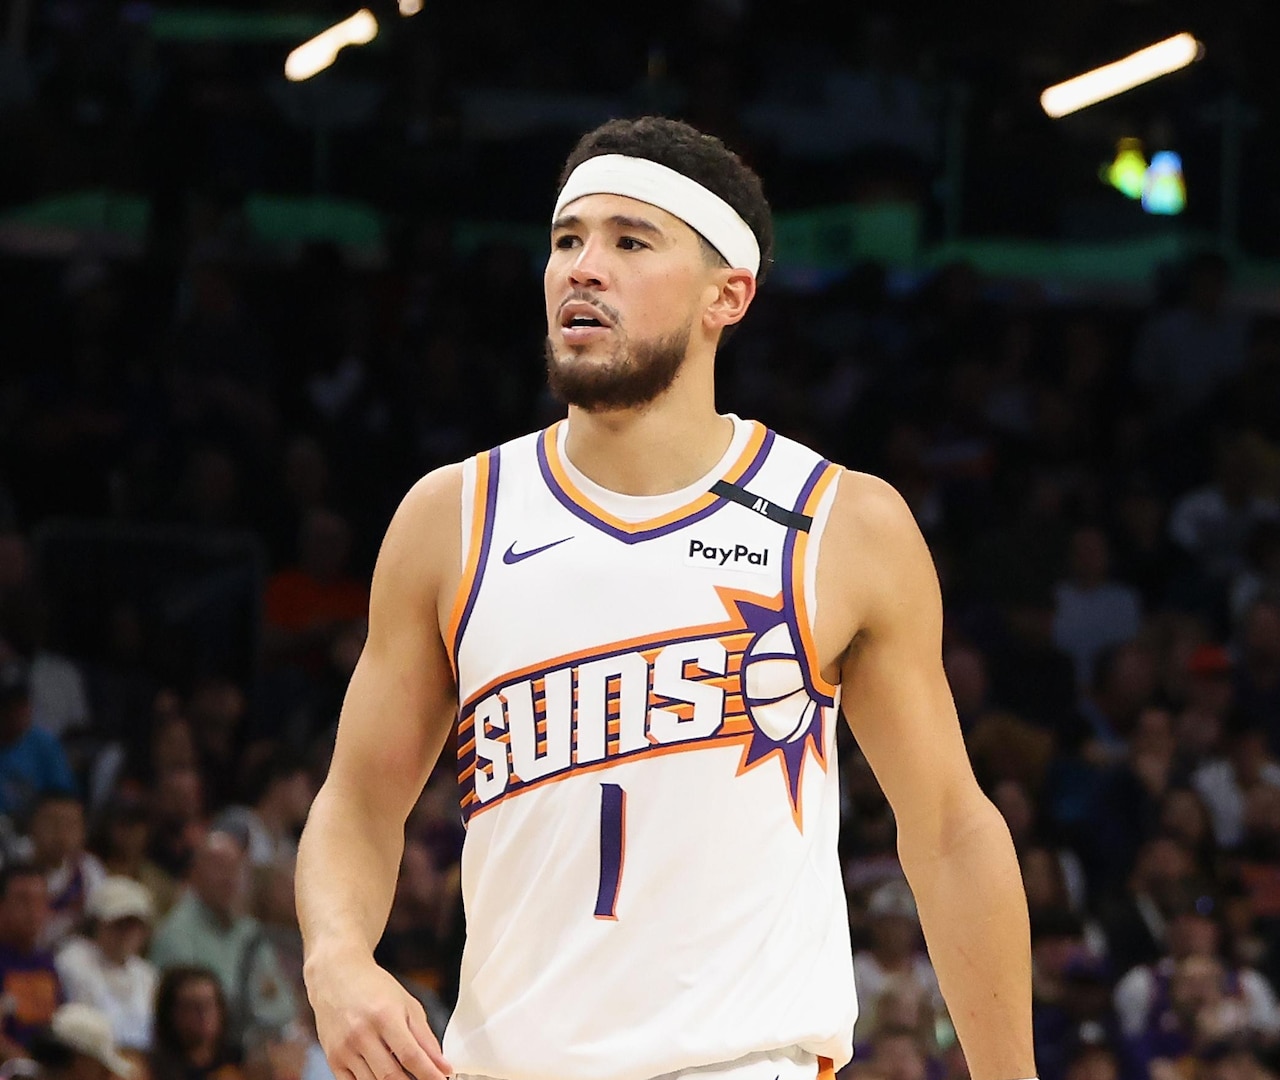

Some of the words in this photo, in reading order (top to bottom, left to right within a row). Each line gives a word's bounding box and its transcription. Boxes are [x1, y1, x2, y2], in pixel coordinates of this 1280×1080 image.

[752, 498, 770, 515] AL
[689, 539, 769, 566] PayPal
[474, 638, 726, 803] SUNS
[593, 782, 627, 921] 1
